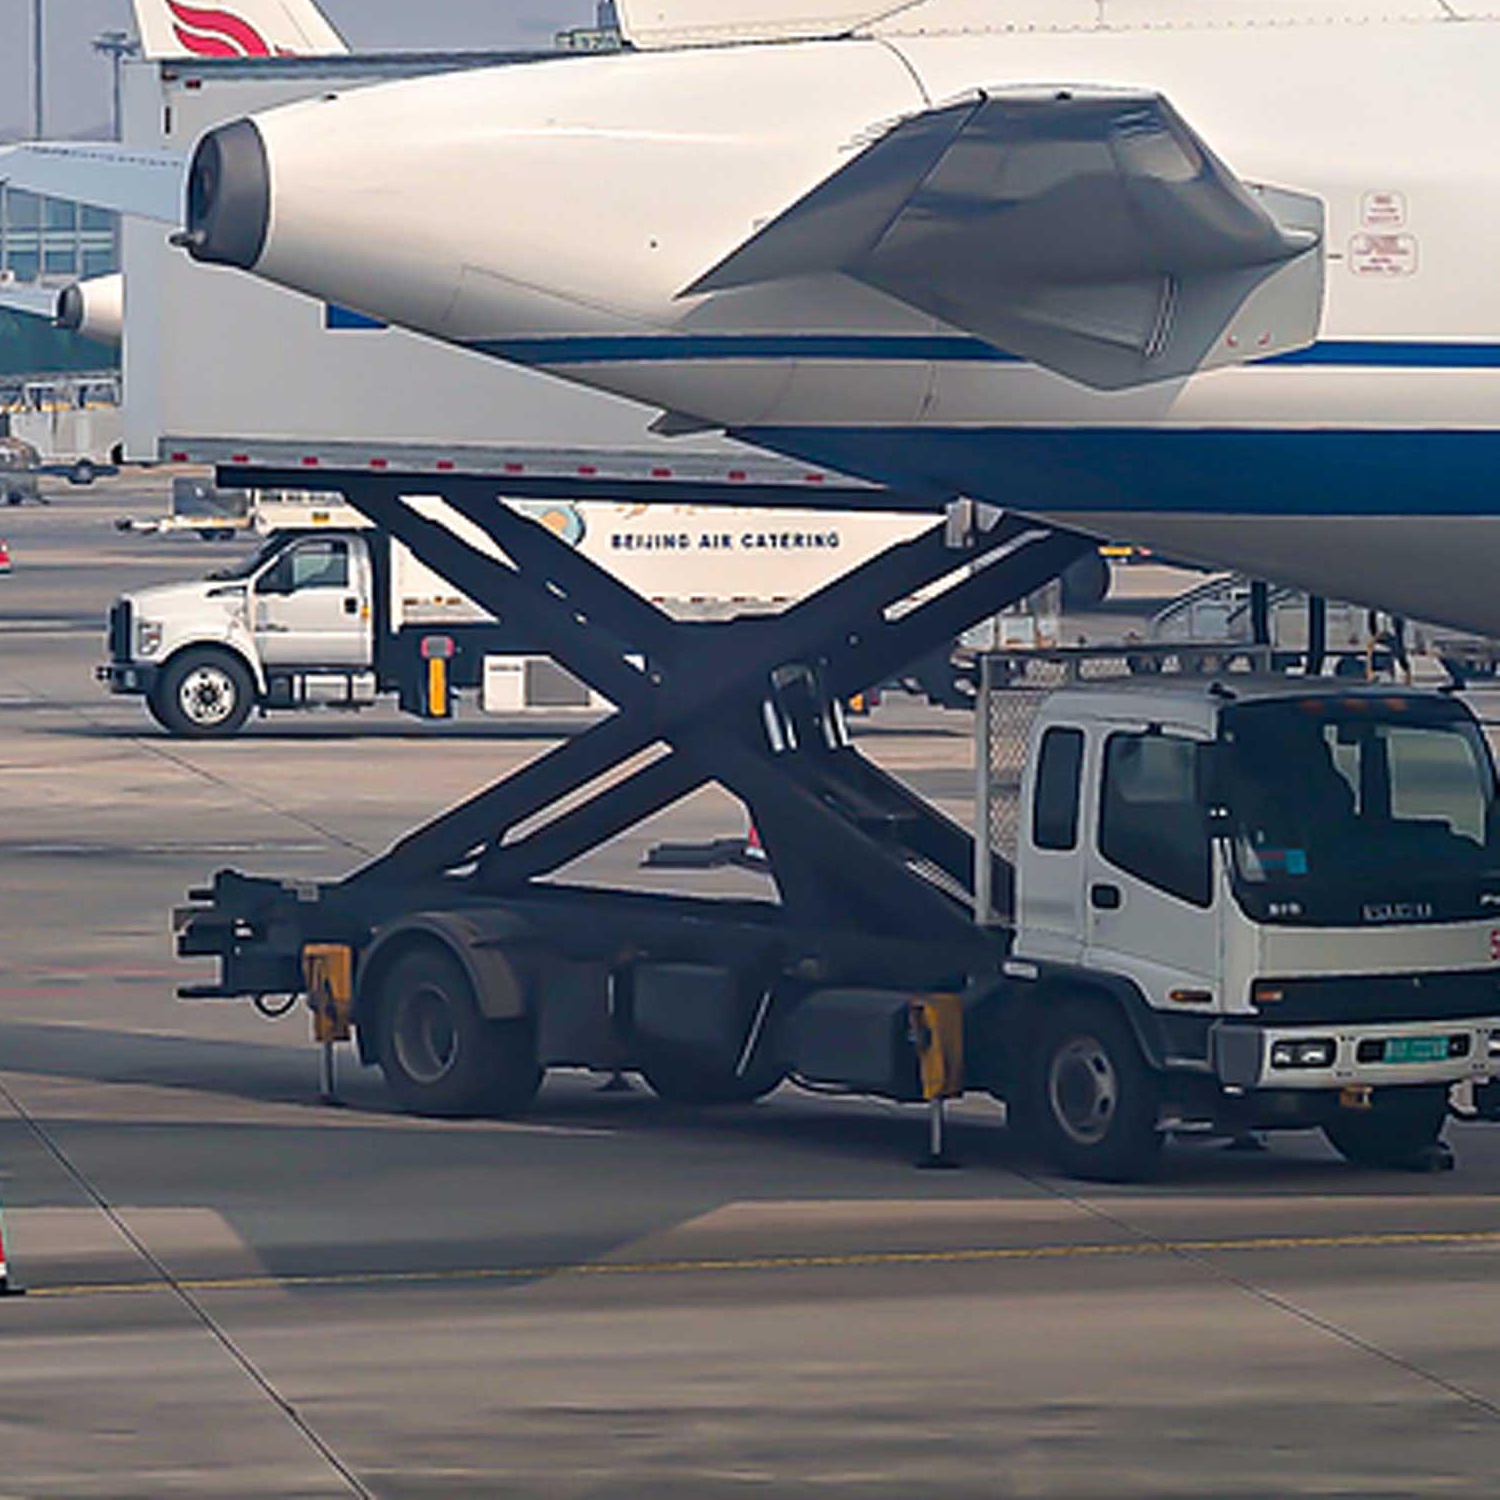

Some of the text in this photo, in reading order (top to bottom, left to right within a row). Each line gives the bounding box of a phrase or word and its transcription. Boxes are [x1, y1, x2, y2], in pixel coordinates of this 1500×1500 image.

[611, 532, 841, 549] BEIJING AIR CATERING
